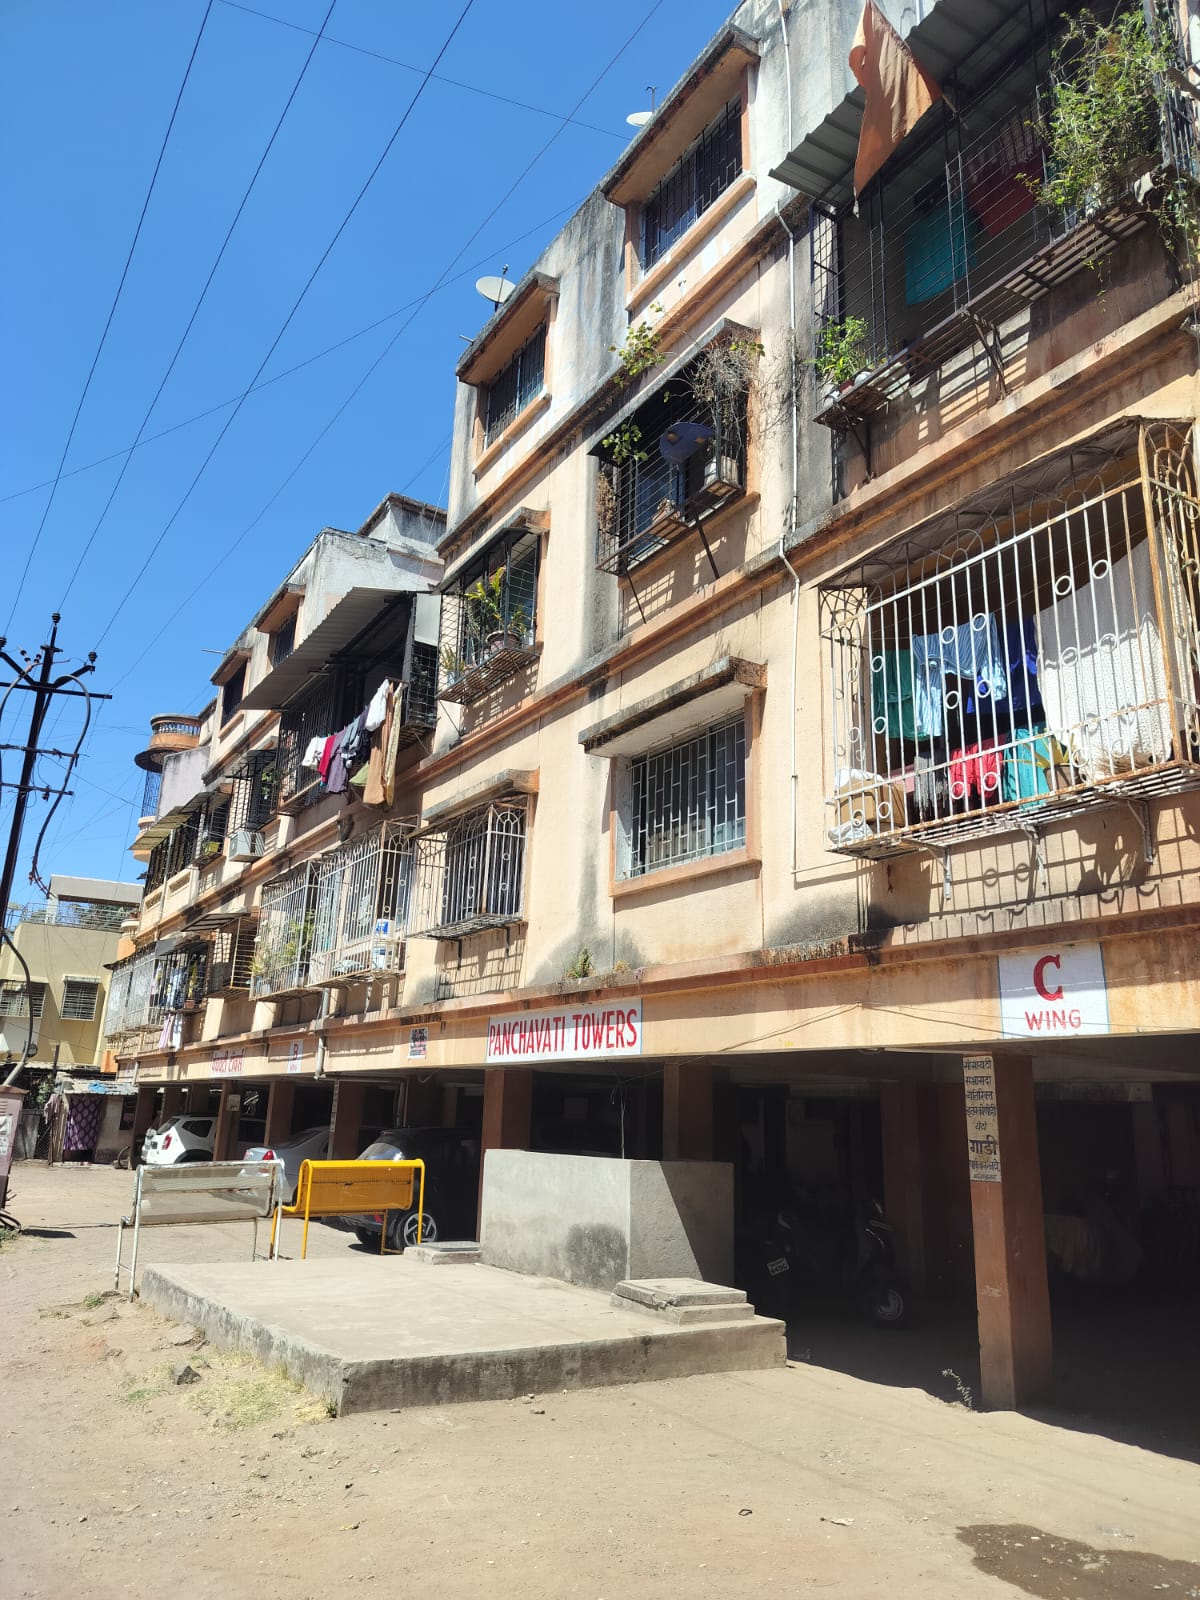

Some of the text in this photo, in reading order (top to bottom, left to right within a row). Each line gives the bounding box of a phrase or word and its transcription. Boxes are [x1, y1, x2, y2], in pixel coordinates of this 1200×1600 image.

[1033, 954, 1063, 1001] C
[488, 1008, 637, 1056] PANCHAVATI TOWERS
[1025, 1009, 1081, 1031] WING
[969, 1134, 999, 1155] गाडी
